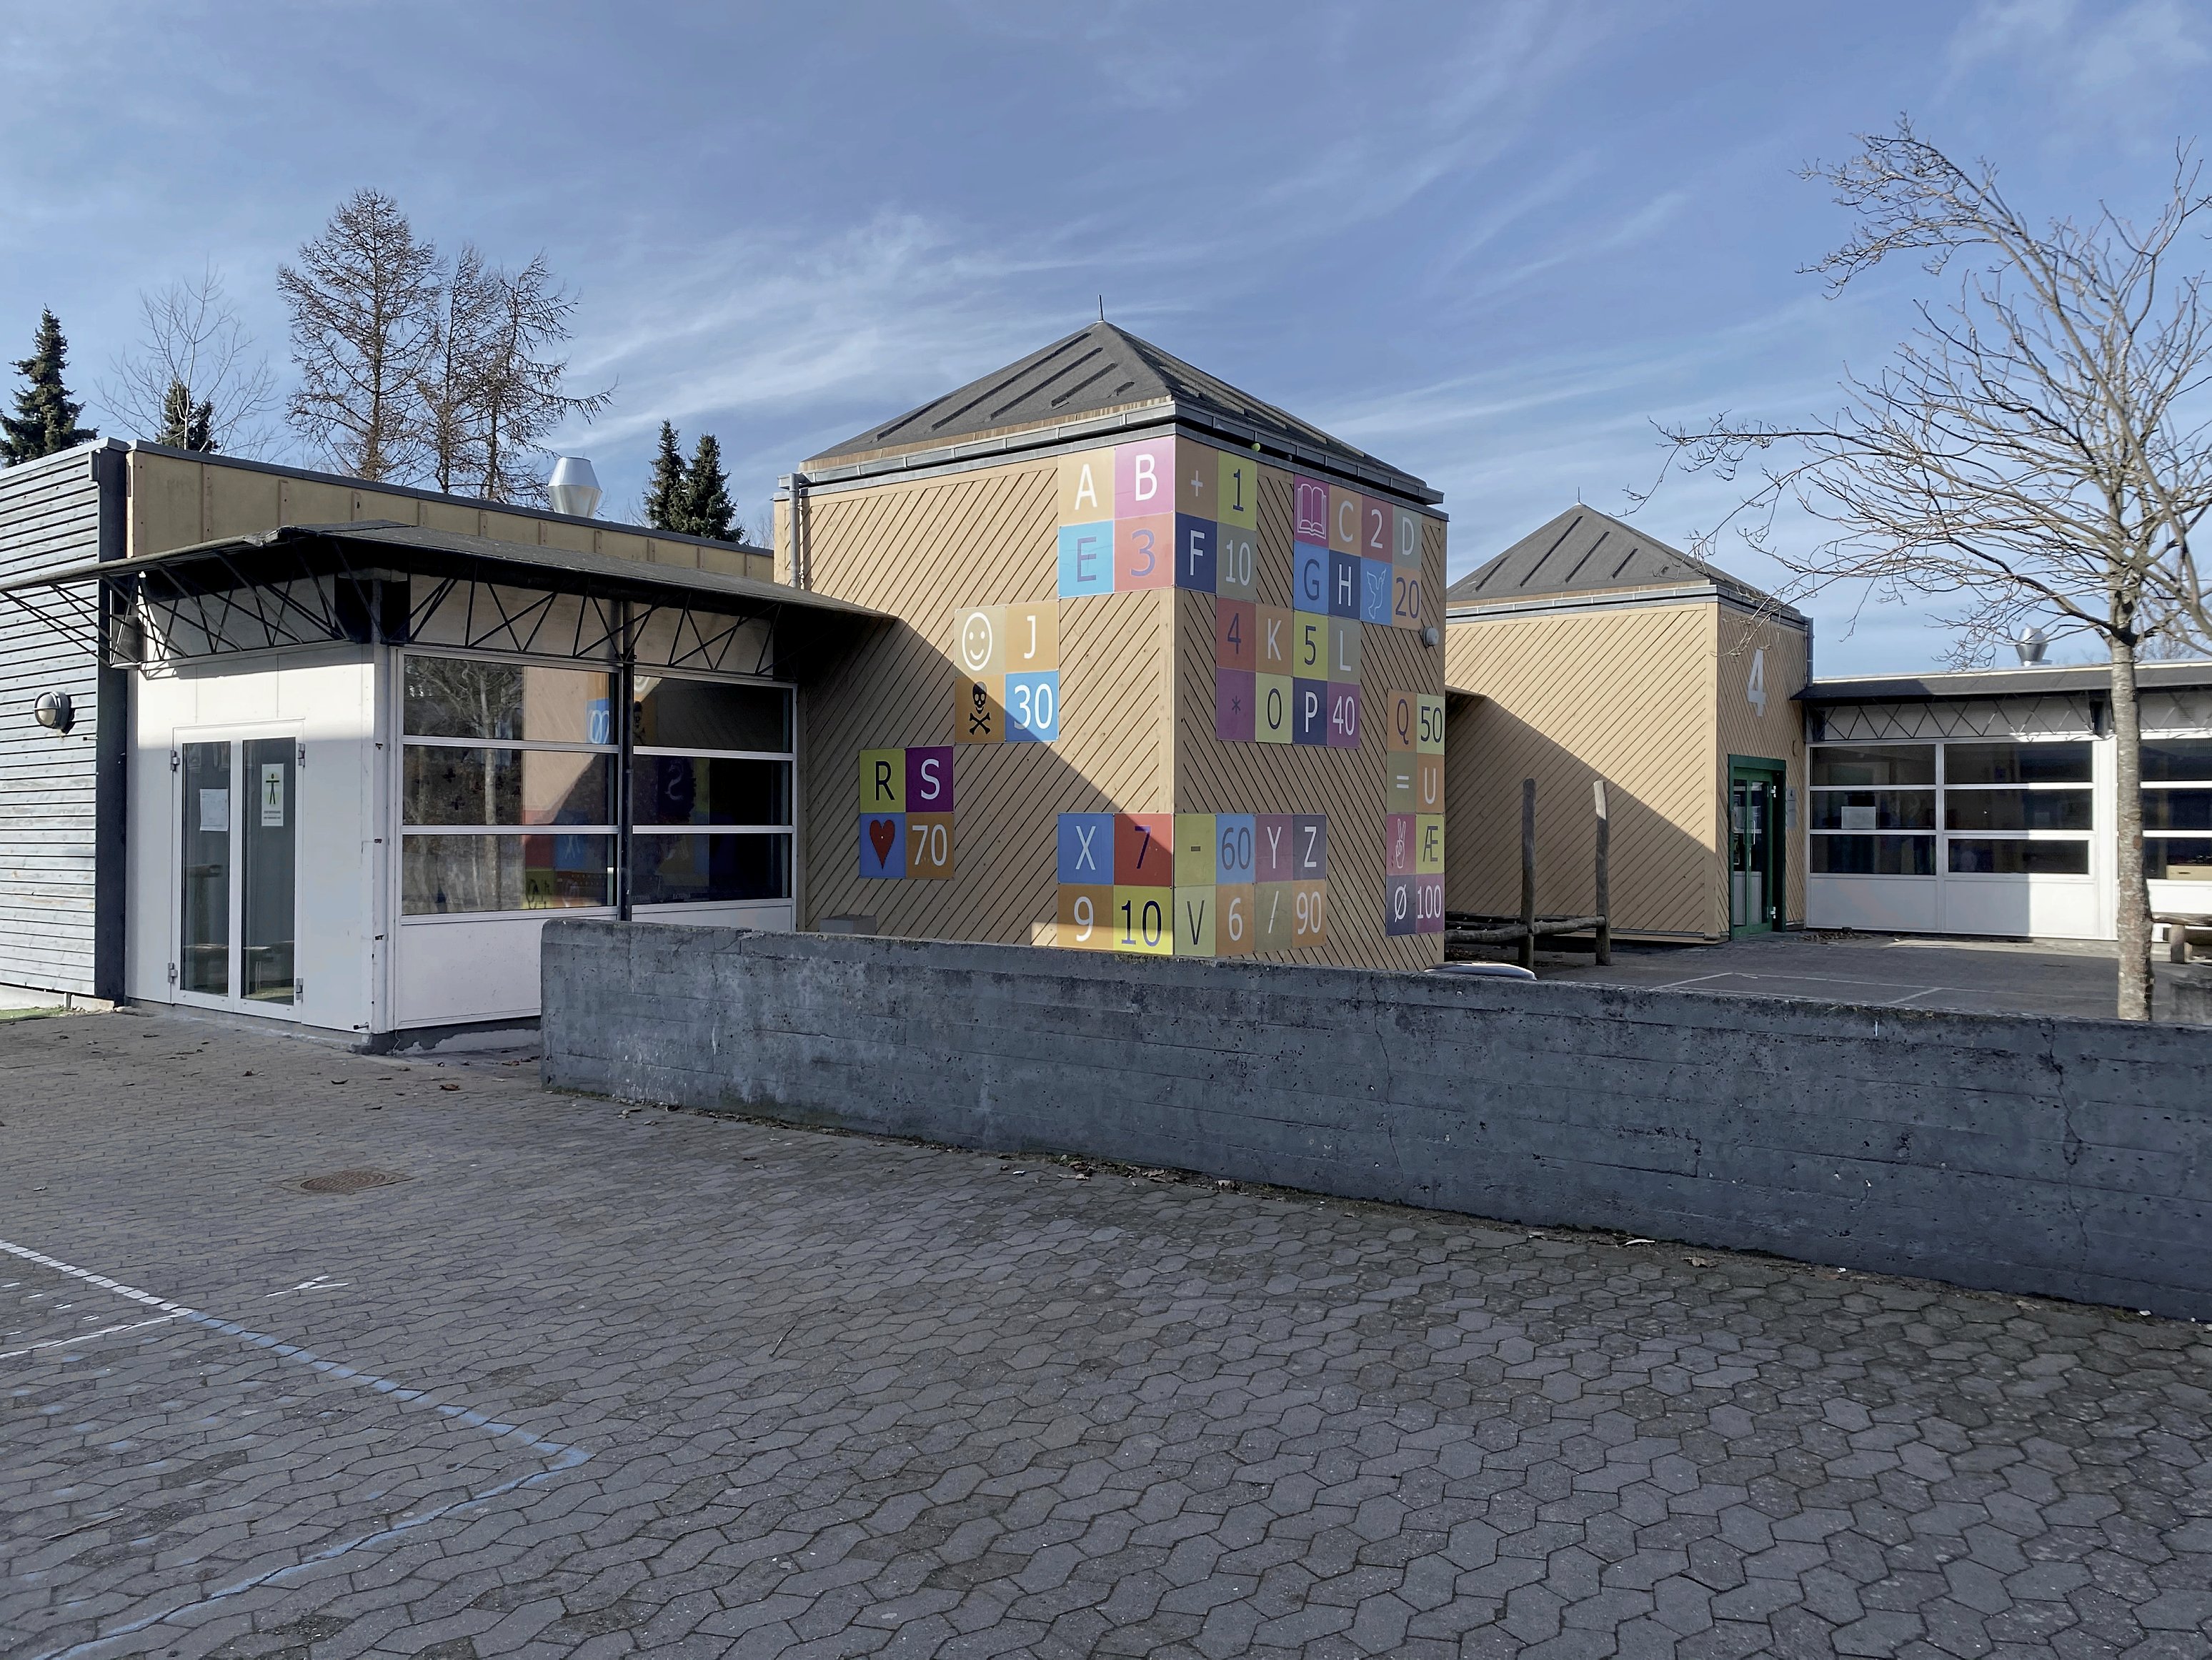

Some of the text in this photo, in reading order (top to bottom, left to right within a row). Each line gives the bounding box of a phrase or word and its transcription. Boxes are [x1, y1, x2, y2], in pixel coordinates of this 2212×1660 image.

[1075, 454, 1158, 510] A B
[1232, 469, 1244, 512] 1
[1339, 501, 1414, 556] C 2 D
[1077, 530, 1156, 582] E 3
[1190, 530, 1252, 586] F 10
[1304, 559, 1351, 607] G H
[1395, 577, 1420, 619] 20
[1024, 615, 1037, 659] J
[1227, 612, 1351, 671] 4 K 5 L
[1748, 649, 1766, 717] 4
[1014, 683, 1053, 730] 30
[1305, 691, 1318, 733] P
[1332, 696, 1355, 736] 40
[1397, 699, 1443, 745] Q 50
[875, 759, 940, 801] R S
[1425, 767, 1436, 805] U
[912, 824, 947, 866] 70
[1075, 825, 1151, 870] X 7
[1222, 827, 1251, 870] 60
[1267, 826, 1282, 869] Y
[1304, 826, 1317, 868] Z
[1423, 825, 1438, 862] Æ
[1074, 896, 1162, 947] 9 10
[1187, 900, 1205, 945] V
[1228, 898, 1242, 941] 6
[1296, 891, 1322, 935] 90
[1394, 884, 1442, 923] Ø 100
